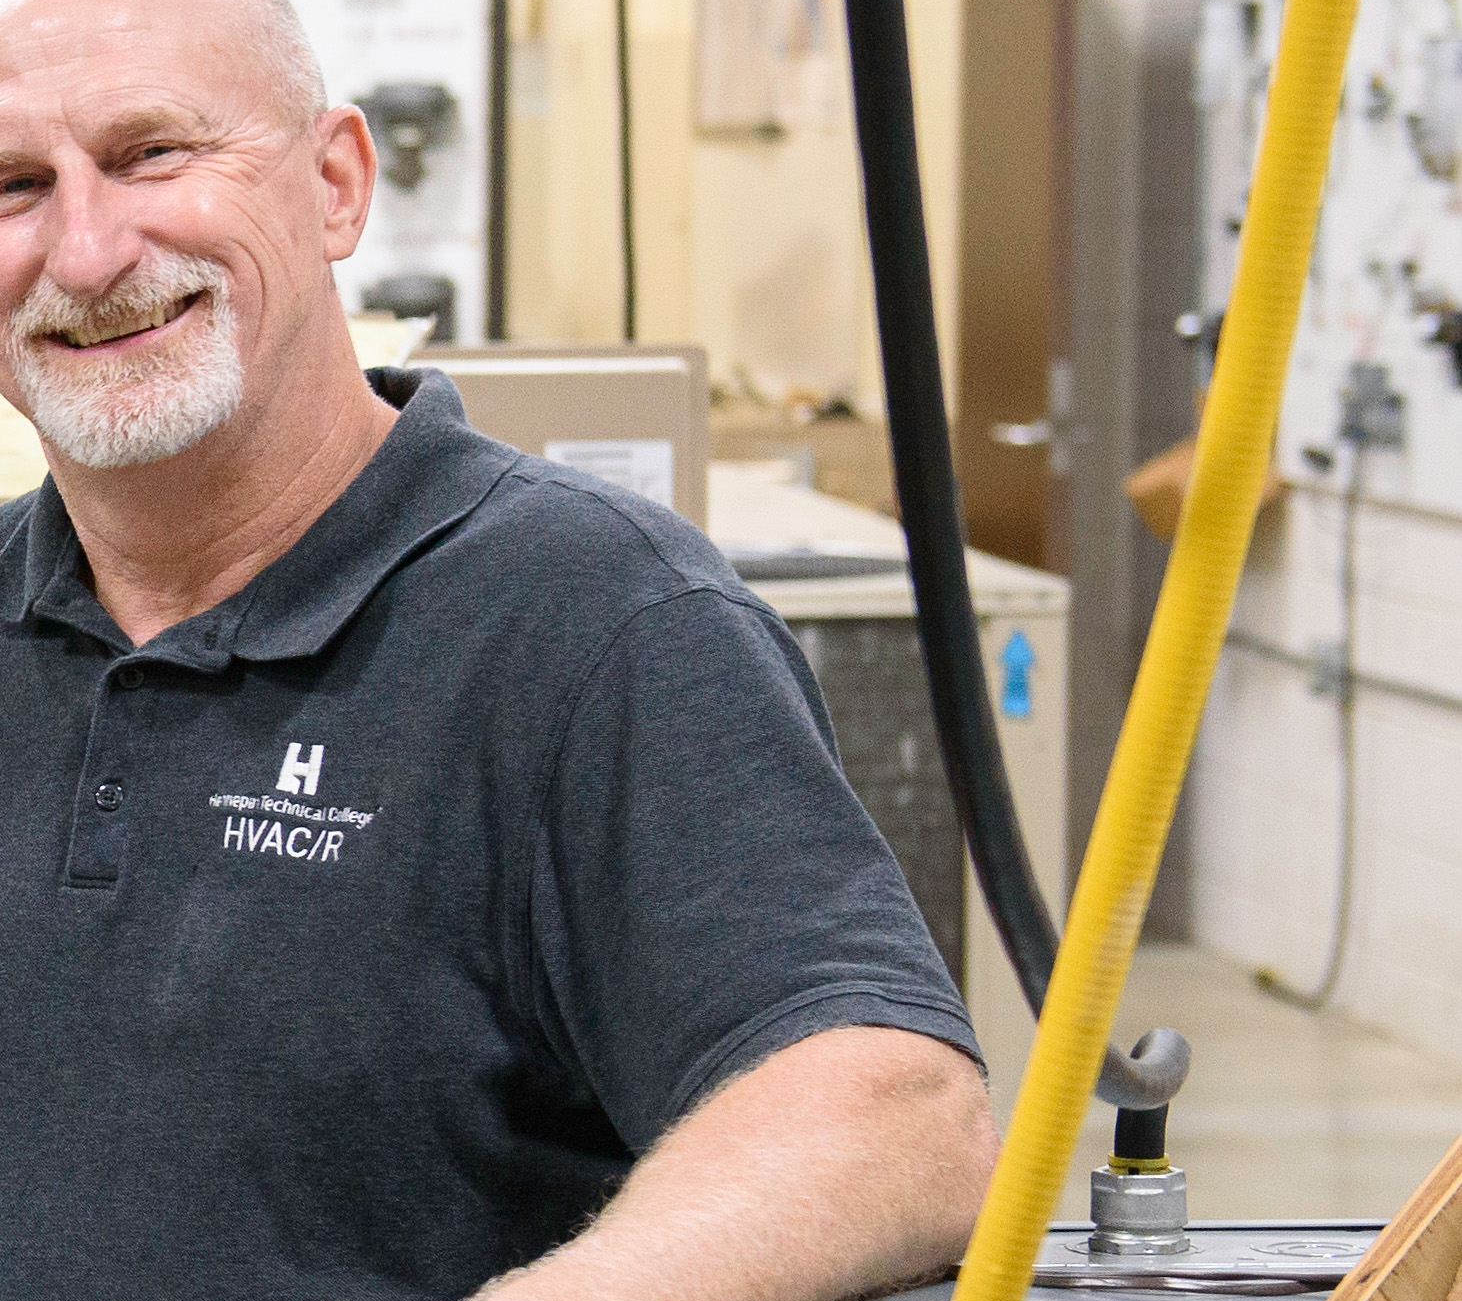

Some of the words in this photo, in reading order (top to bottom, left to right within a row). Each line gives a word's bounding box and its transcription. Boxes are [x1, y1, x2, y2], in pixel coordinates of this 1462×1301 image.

[275, 742, 325, 796] H
[260, 794, 326, 821] Technical
[328, 806, 375, 829] College
[223, 815, 344, 862] HVAC/R
